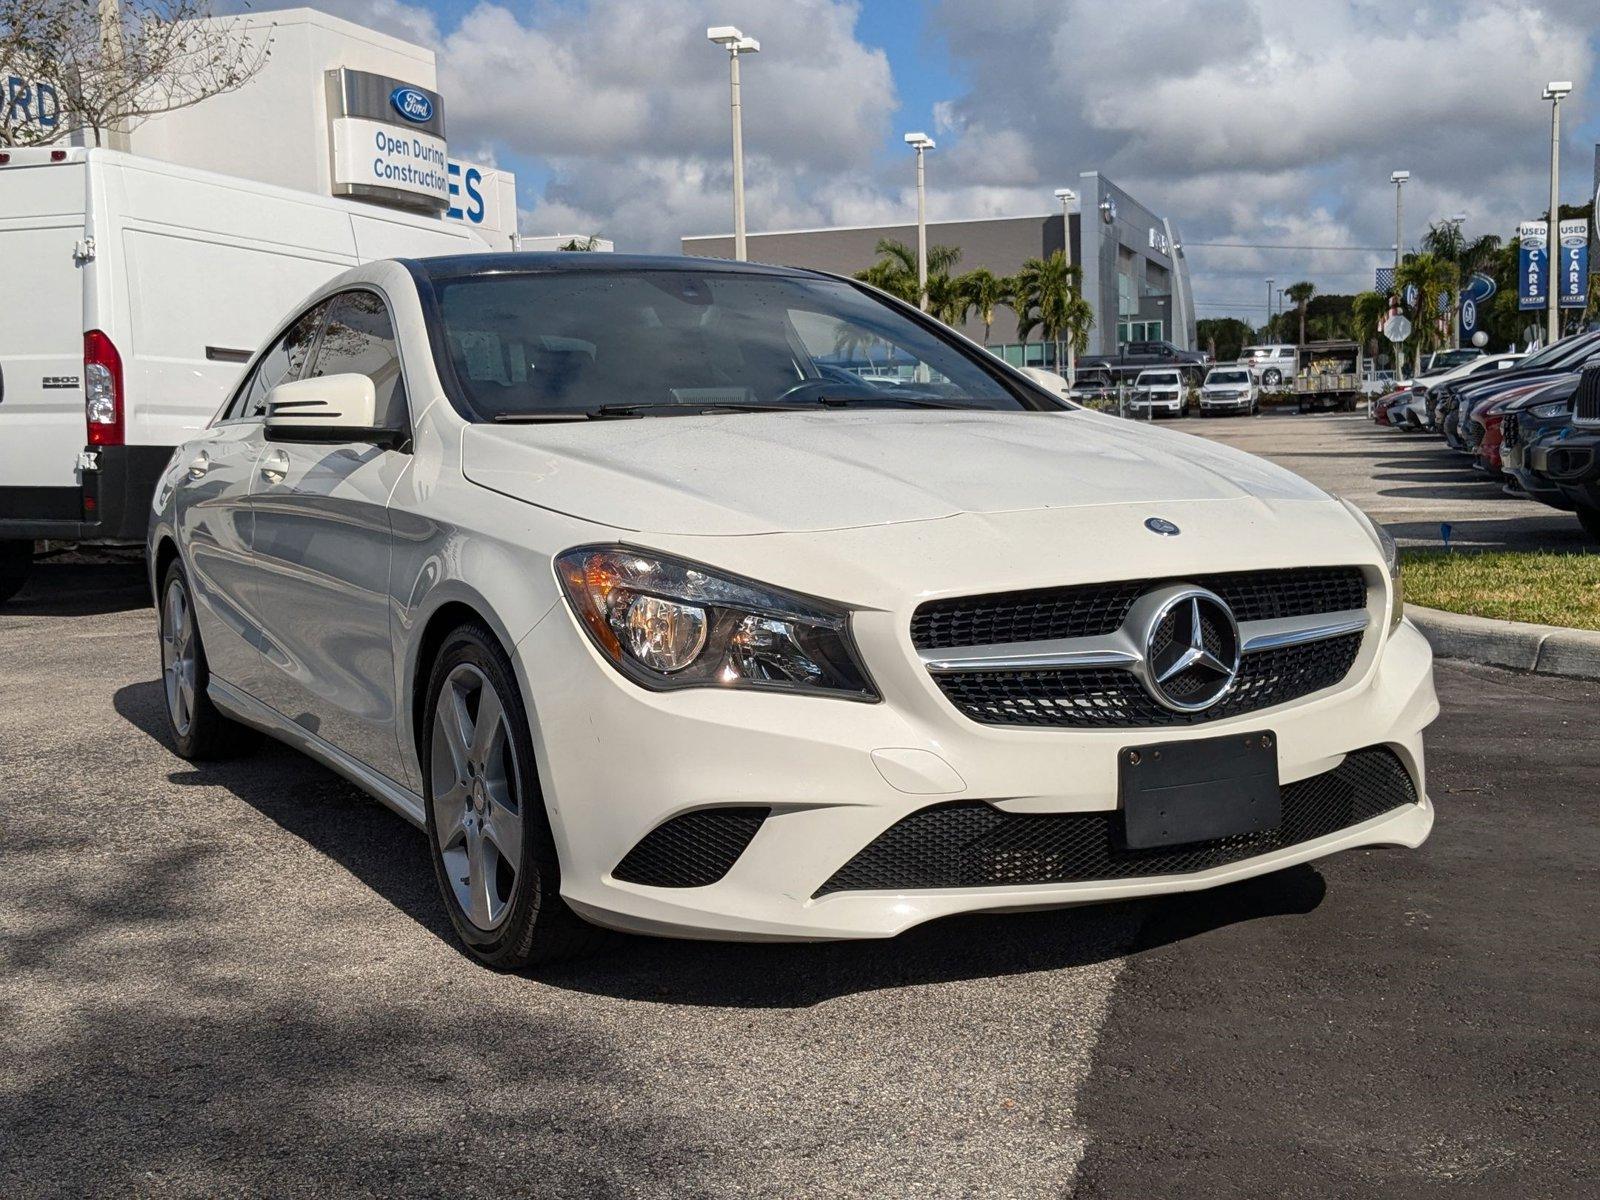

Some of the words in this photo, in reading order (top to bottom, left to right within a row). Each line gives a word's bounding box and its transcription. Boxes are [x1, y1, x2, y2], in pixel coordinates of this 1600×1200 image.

[0, 76, 60, 126] RD
[403, 91, 428, 117] Ford
[375, 131, 410, 157] Open
[413, 139, 445, 169] During
[374, 158, 447, 191] Construction
[1521, 227, 1546, 236] USED
[1561, 225, 1586, 235] USED
[1528, 250, 1539, 296] CARS
[1569, 249, 1580, 295] CARS
